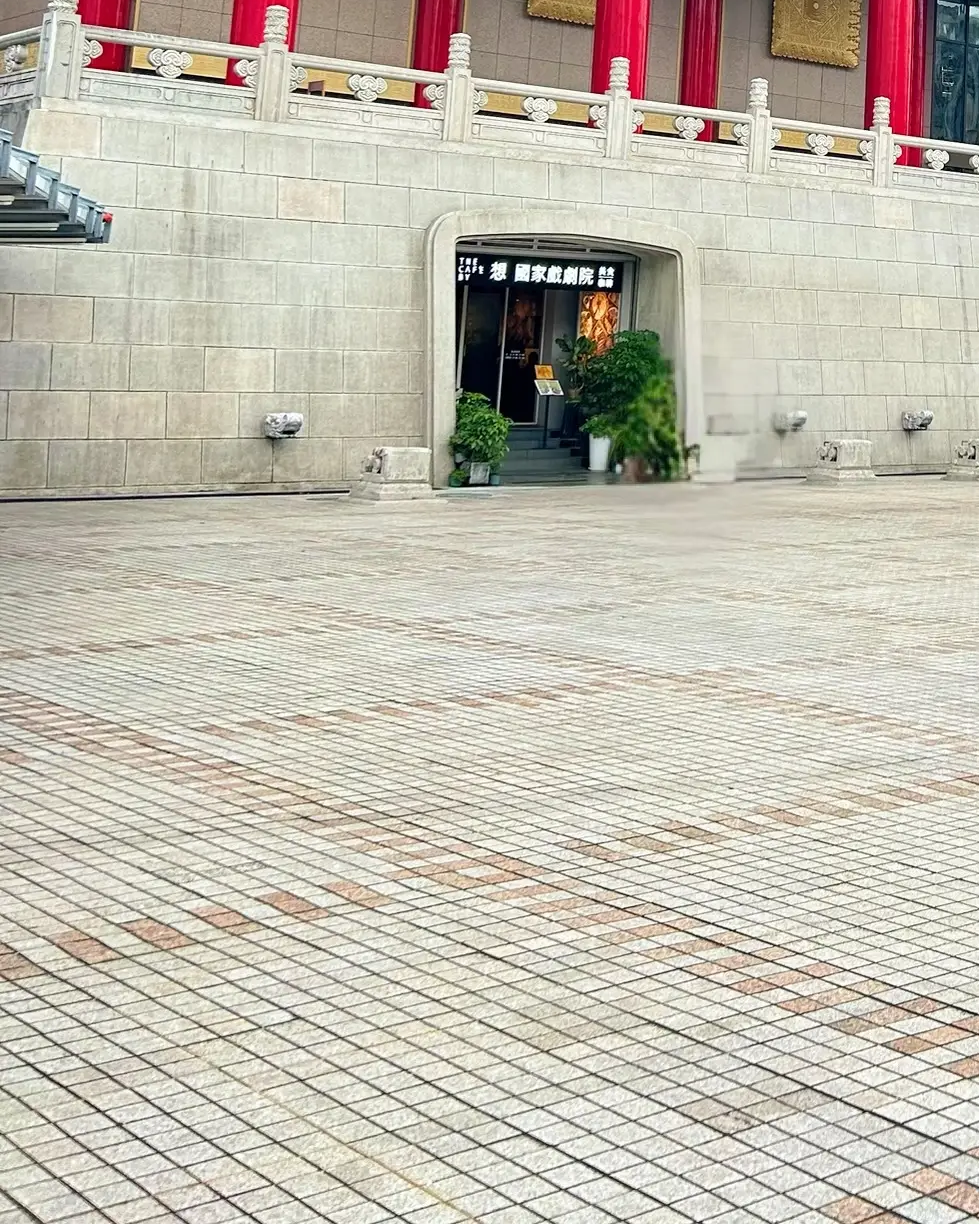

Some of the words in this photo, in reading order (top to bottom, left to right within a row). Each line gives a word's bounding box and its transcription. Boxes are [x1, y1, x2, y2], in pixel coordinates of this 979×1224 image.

[459, 257, 478, 266] THE
[457, 273, 470, 281] BY
[490, 261, 508, 282] 想
[514, 263, 594, 285] 國家戲劇院
